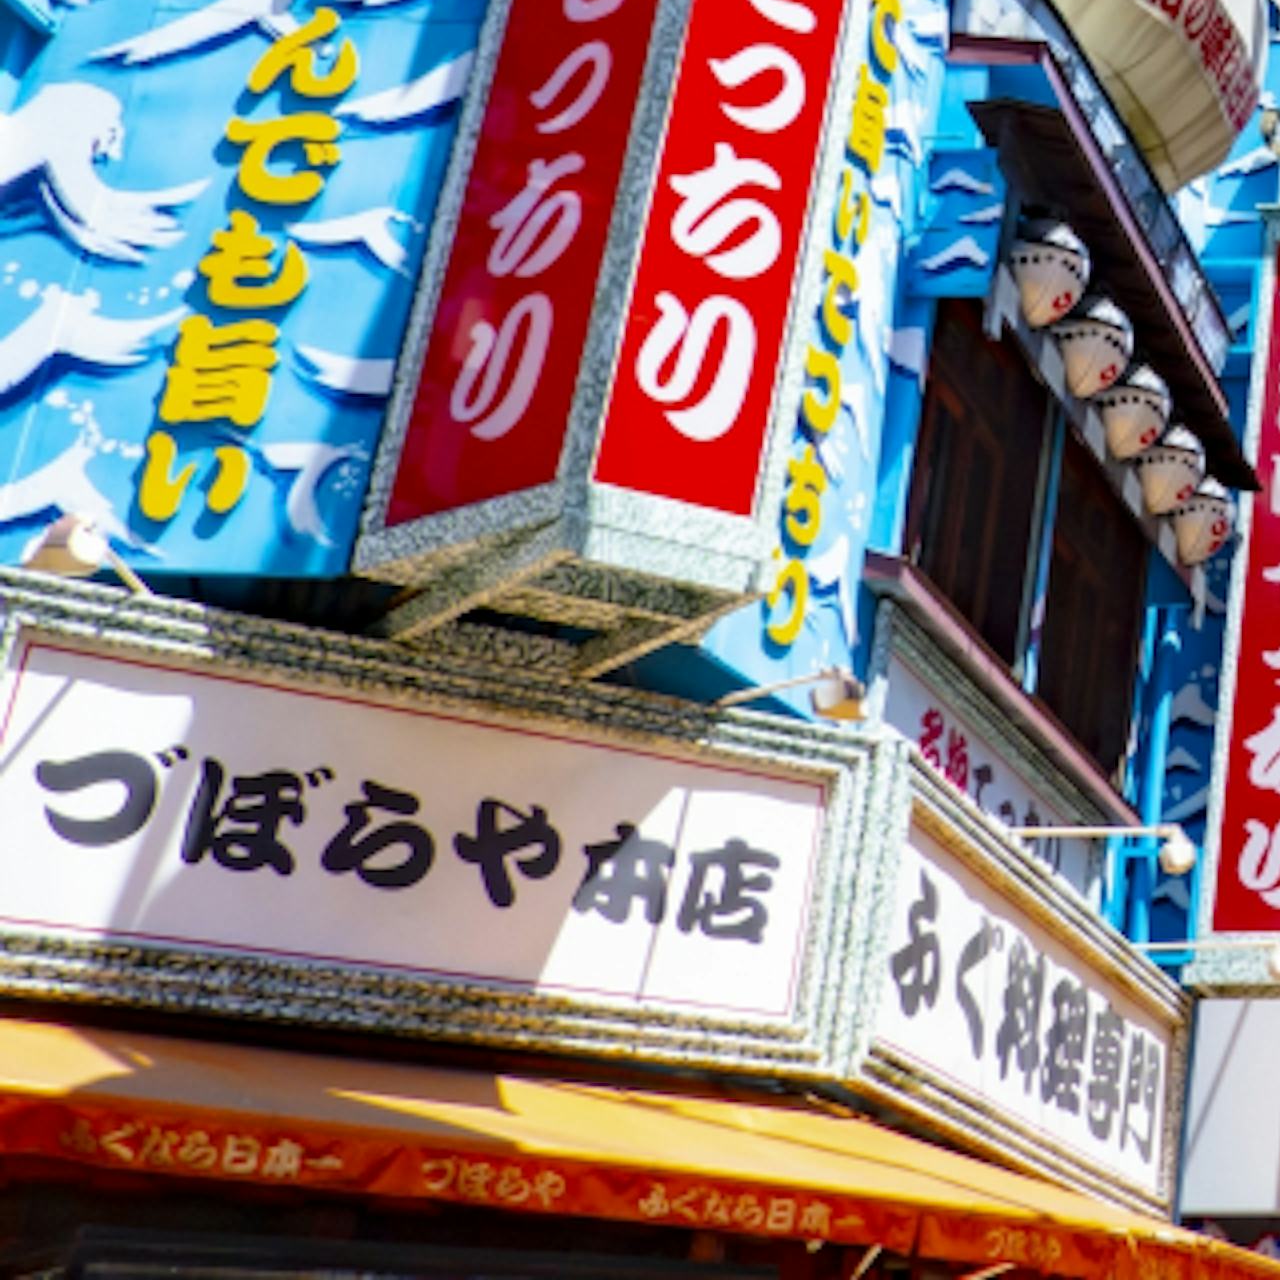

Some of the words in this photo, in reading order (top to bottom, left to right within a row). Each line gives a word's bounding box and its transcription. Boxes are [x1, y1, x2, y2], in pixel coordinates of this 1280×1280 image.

[35, 745, 781, 946] づぼらや本店
